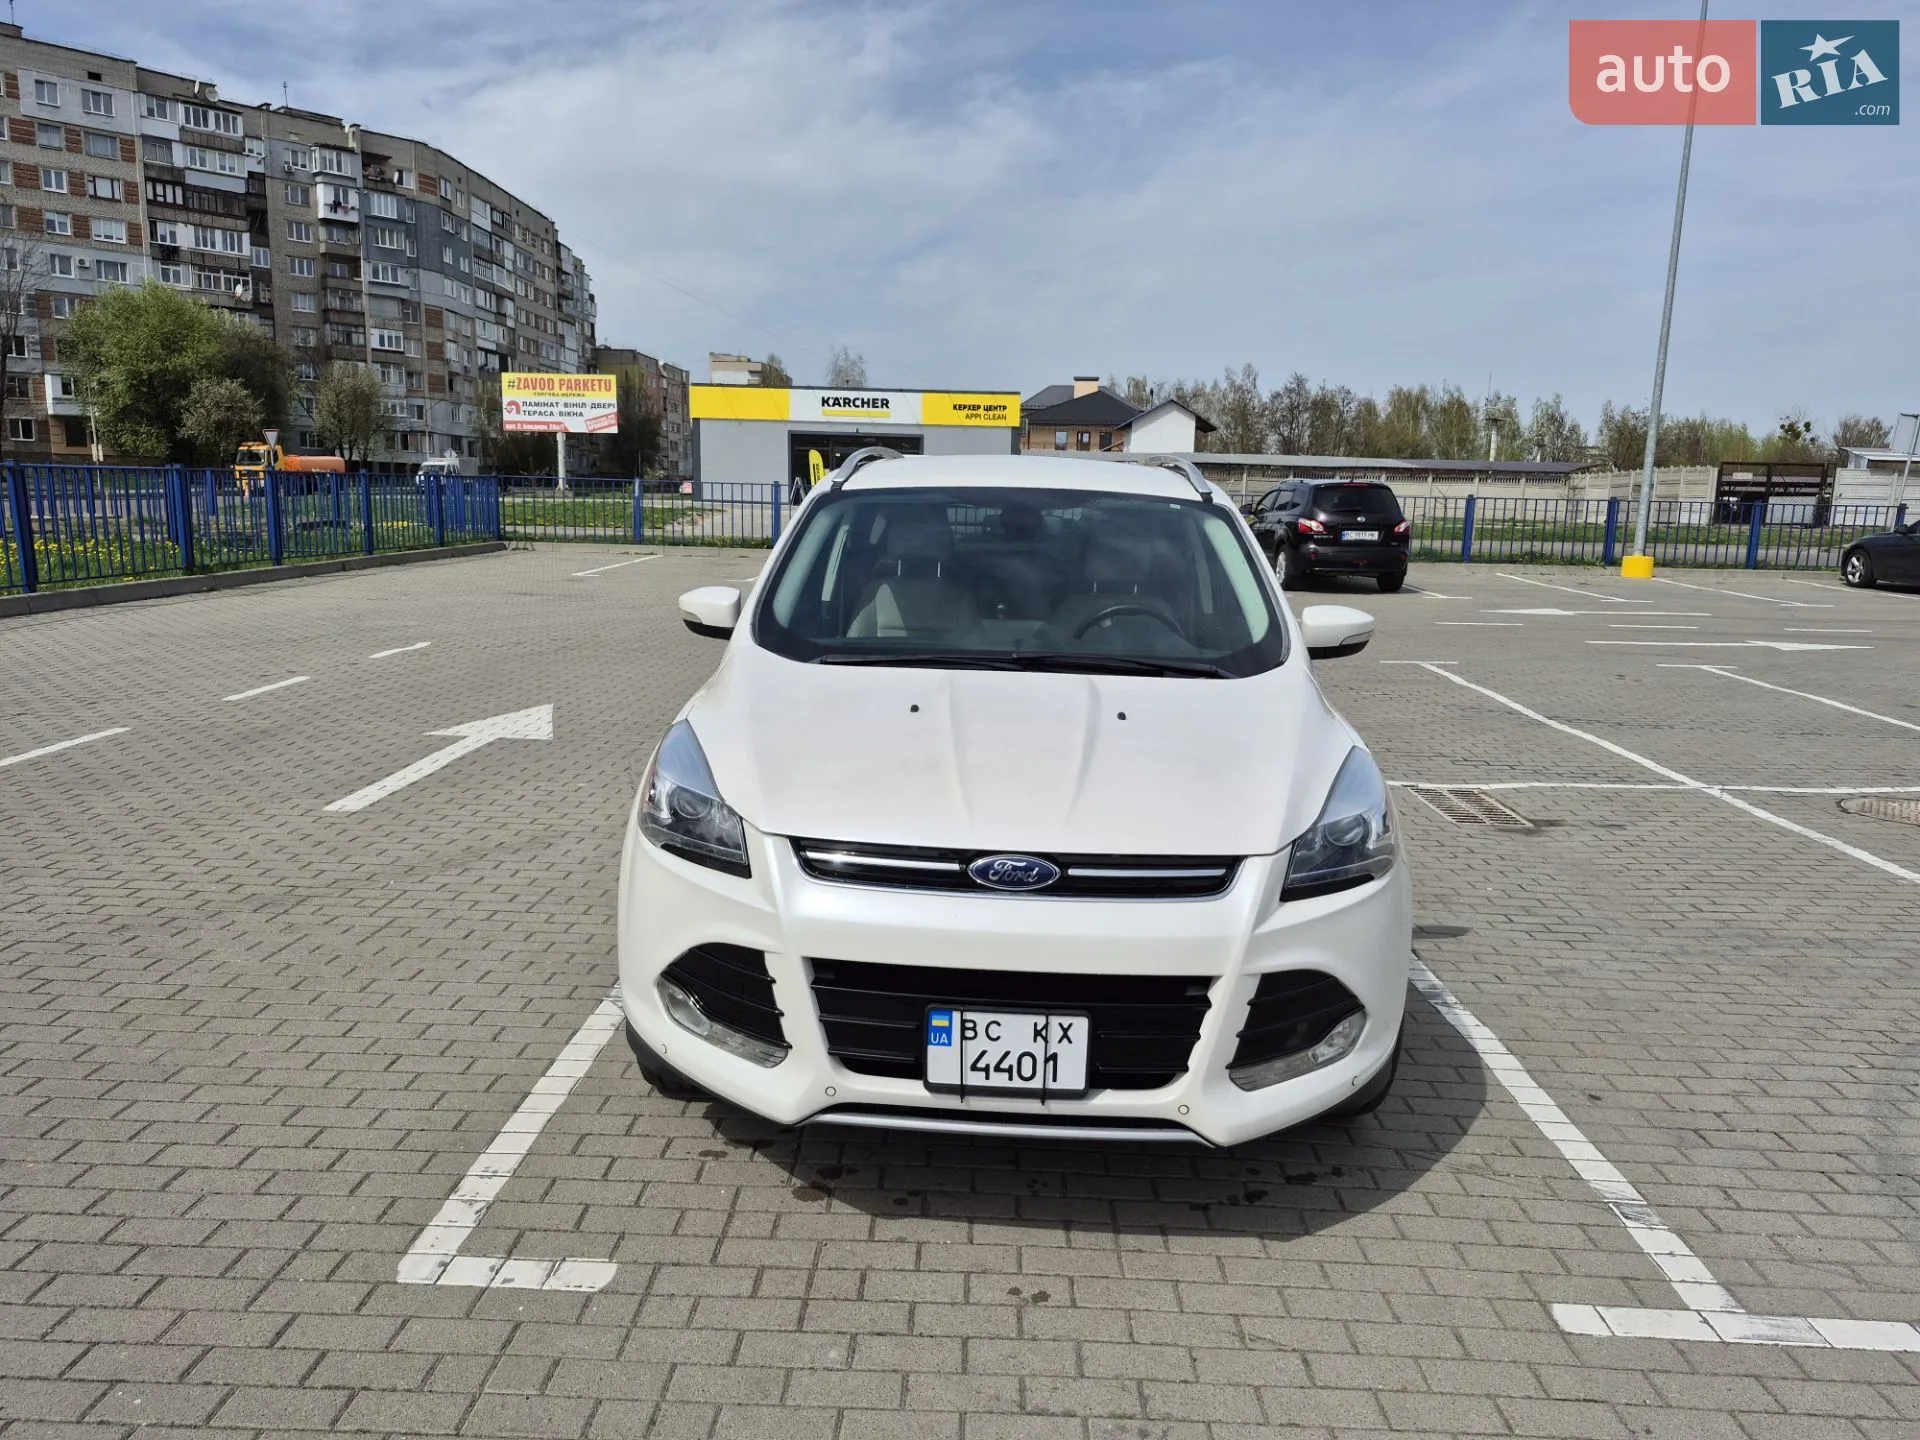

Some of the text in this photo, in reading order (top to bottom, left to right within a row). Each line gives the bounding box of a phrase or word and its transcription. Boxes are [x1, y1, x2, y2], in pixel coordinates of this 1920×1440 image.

[507, 377, 612, 392] #ZAVOD PARKETU
[821, 396, 890, 409] KÄRCHER
[983, 404, 1008, 412] ЦЕНТР
[989, 859, 1039, 882] Ford
[961, 1019, 1001, 1042] BC
[931, 1032, 949, 1045] UA
[970, 1049, 1058, 1083] 4401
